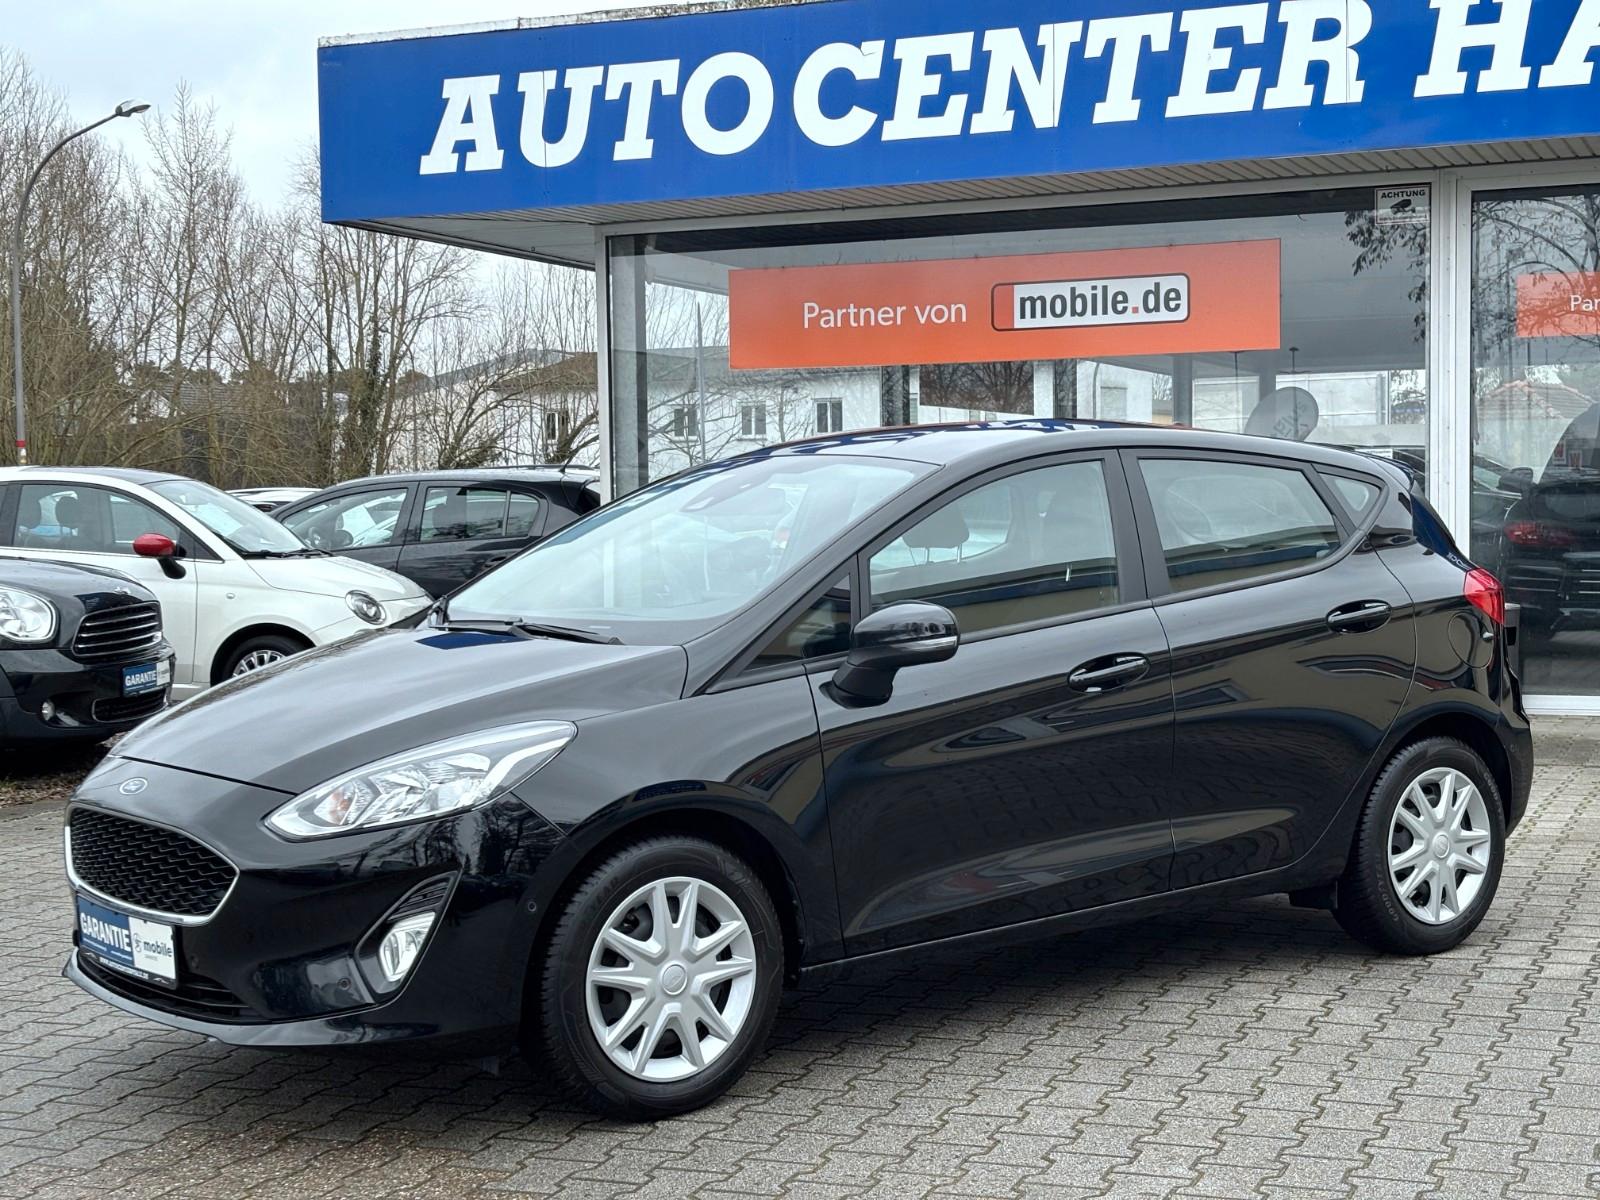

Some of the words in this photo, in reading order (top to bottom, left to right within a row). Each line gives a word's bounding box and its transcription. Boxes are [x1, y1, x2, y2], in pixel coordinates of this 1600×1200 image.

[1381, 190, 1425, 199] ACHTUNG
[803, 302, 906, 329] Partner
[914, 303, 967, 324] von
[1019, 282, 1182, 319] mobile.de
[80, 912, 132, 952] GARANTIE
[143, 940, 173, 958] mobile
